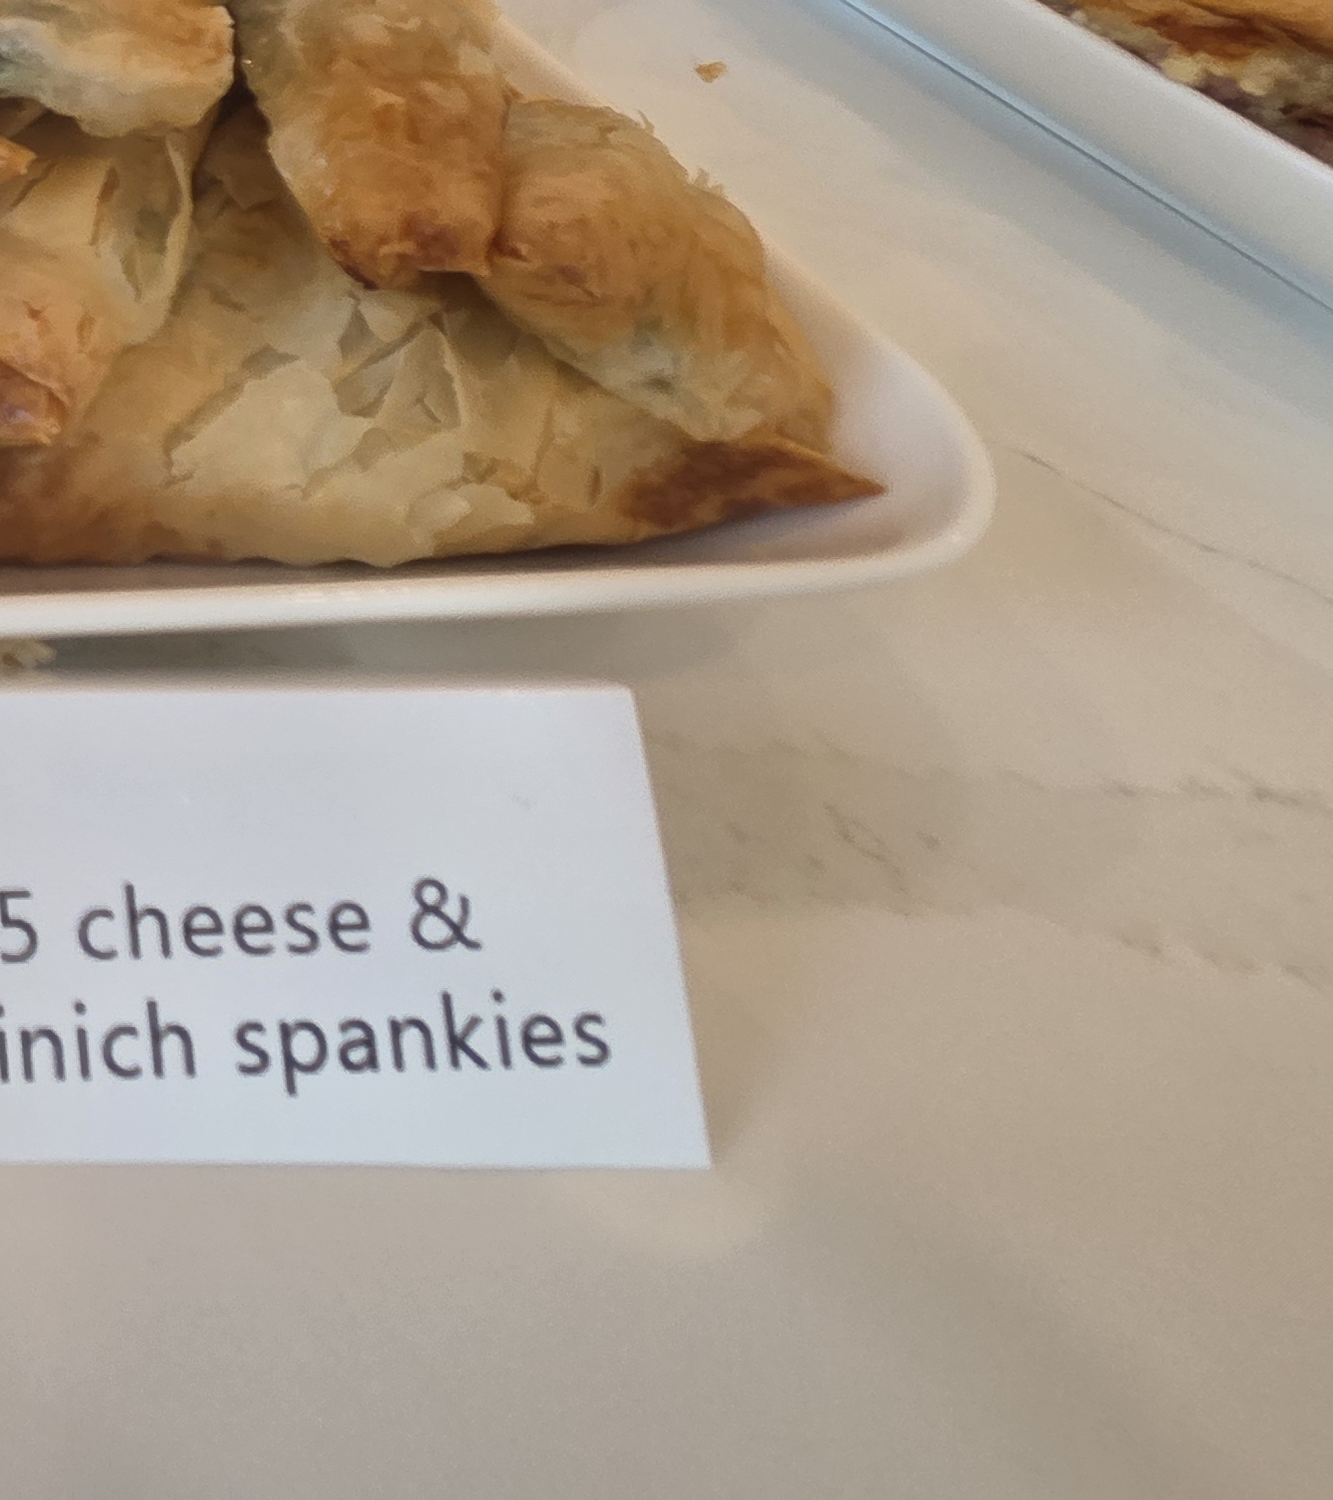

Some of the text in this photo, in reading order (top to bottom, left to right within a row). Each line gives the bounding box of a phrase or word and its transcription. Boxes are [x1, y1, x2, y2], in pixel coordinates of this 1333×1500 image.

[77, 882, 371, 961] cheese
[410, 876, 482, 952] &
[233, 988, 612, 1097] spankies
